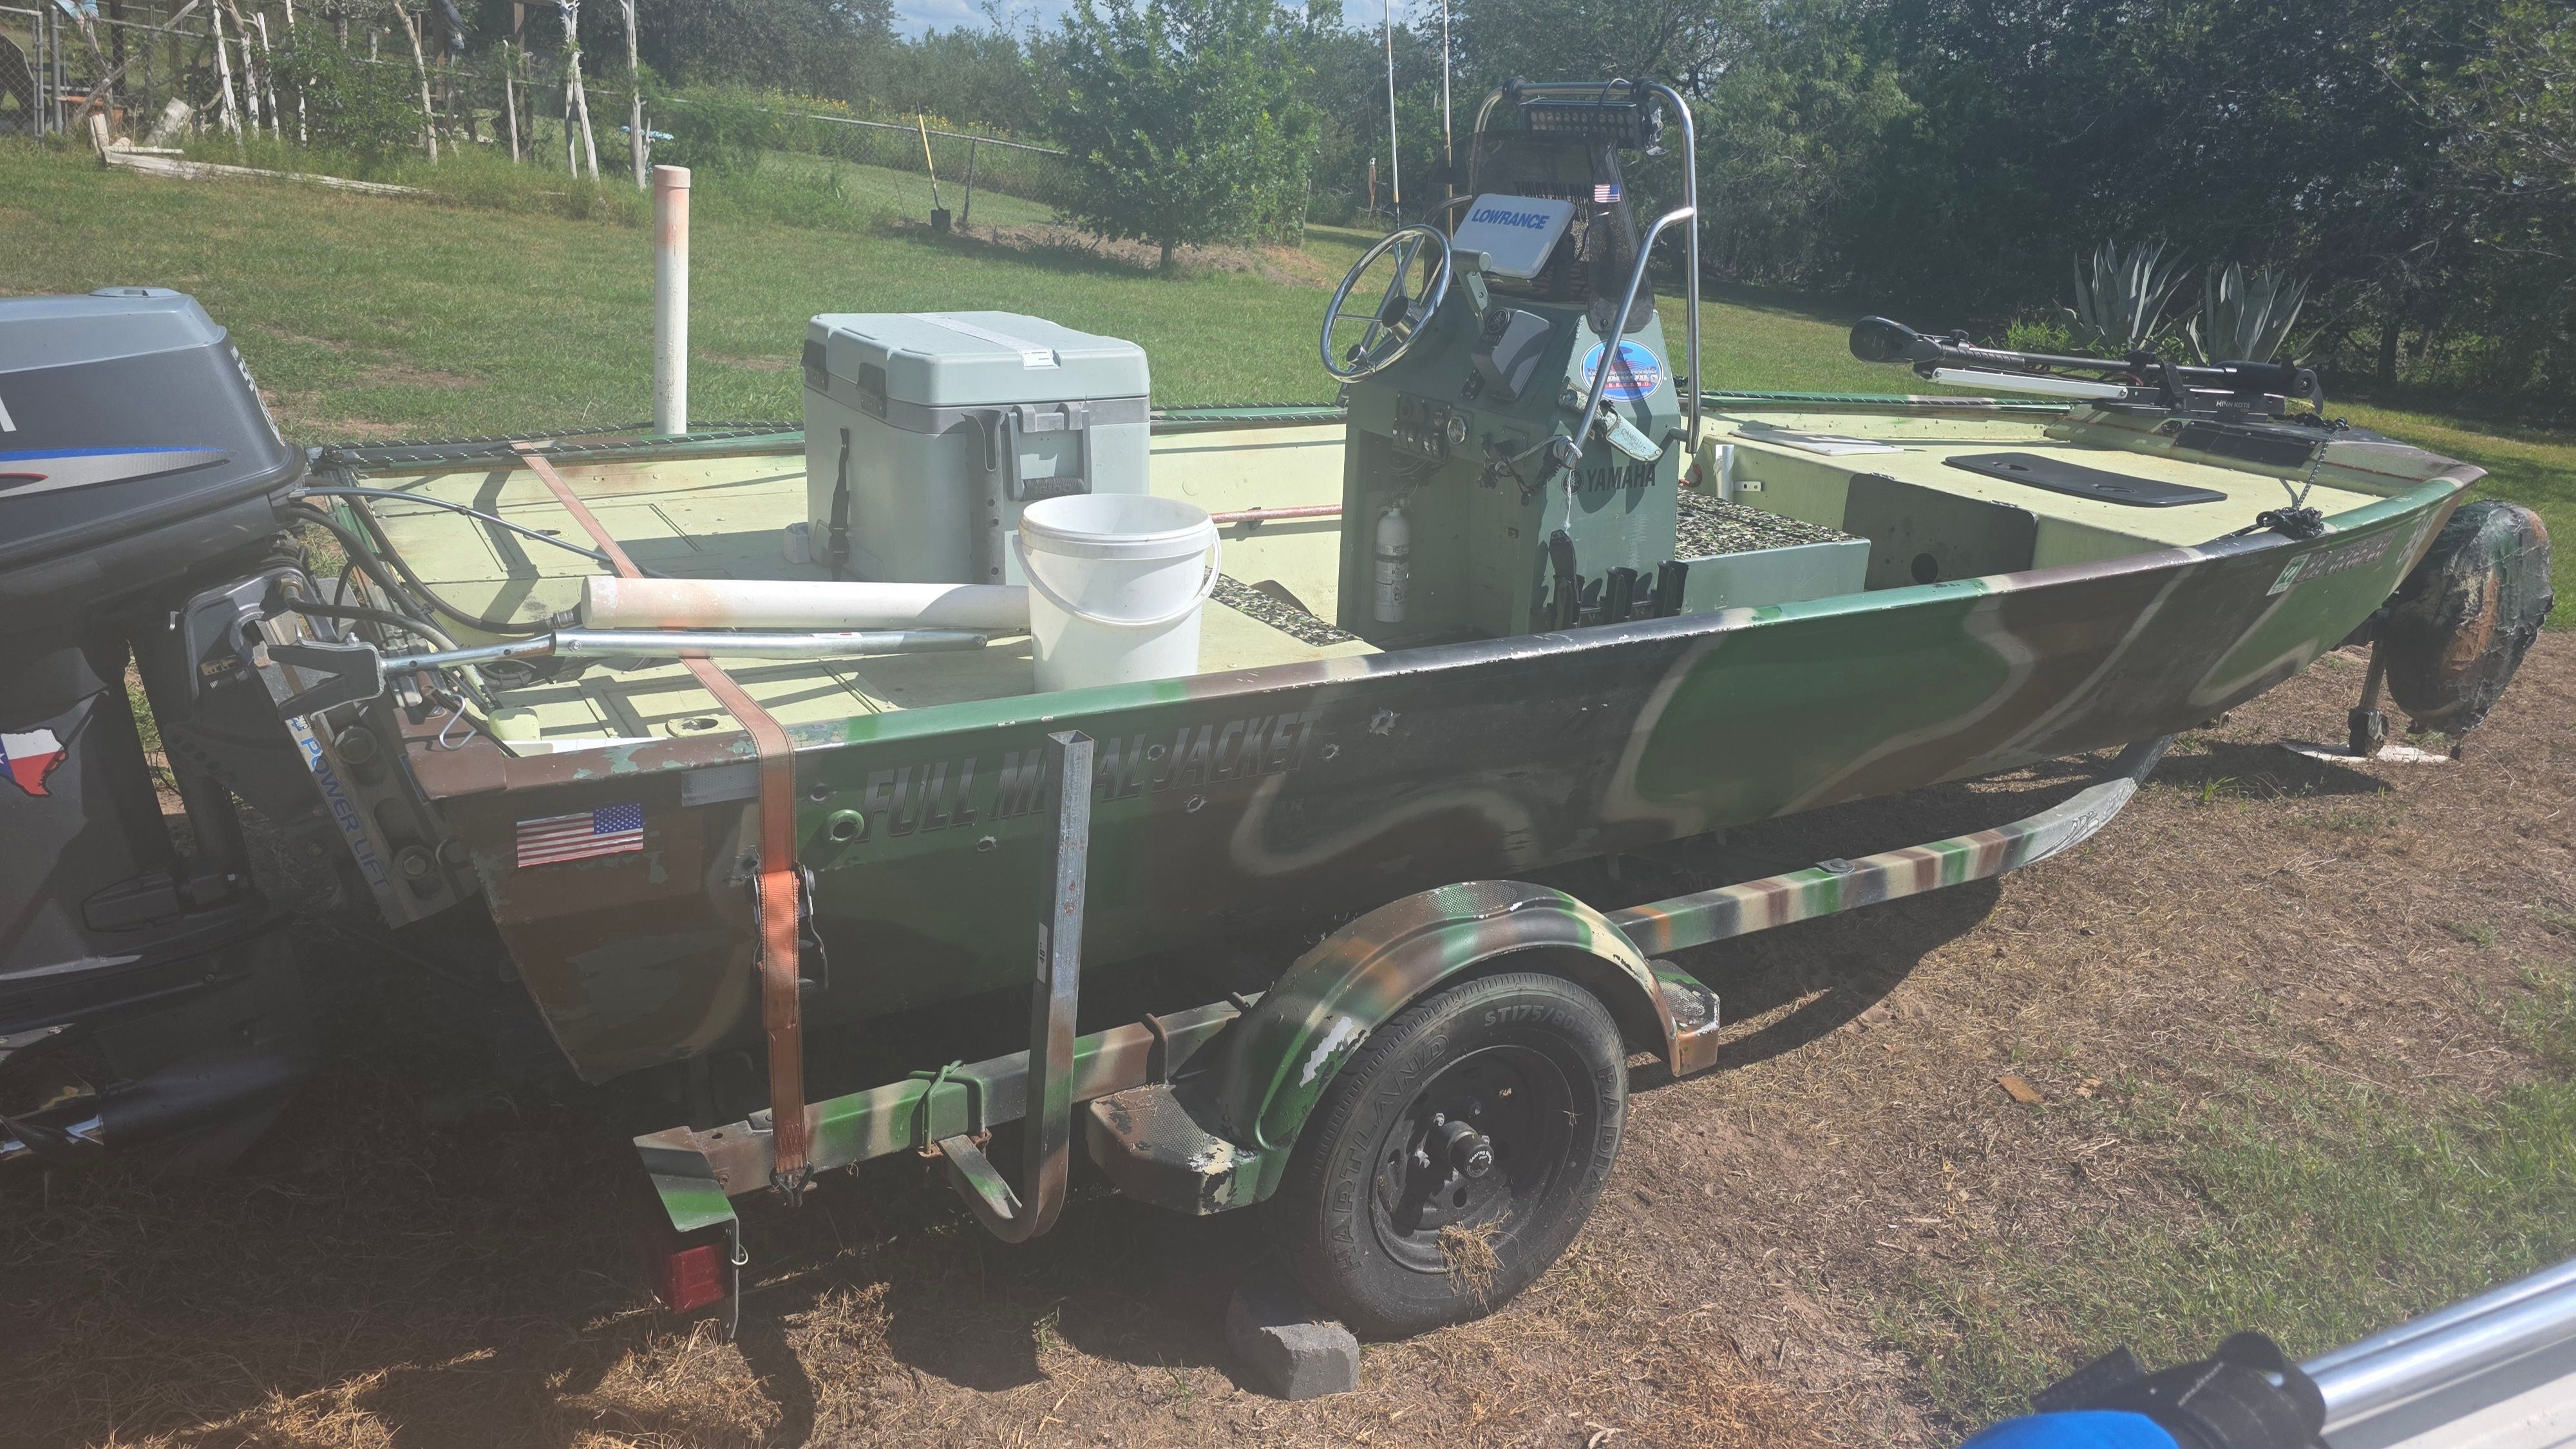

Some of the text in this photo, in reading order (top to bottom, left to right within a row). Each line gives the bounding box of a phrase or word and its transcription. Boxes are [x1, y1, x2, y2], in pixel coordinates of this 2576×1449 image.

[1471, 209, 1549, 230] LOWRANCE
[1587, 464, 1655, 492] YAMAHA
[299, 737, 392, 889] POWER LIFT
[854, 710, 1323, 844] FULL MAL JACKET
[1331, 1034, 1450, 1277] HARTLAND
[1577, 1064, 1620, 1219] RADIAL
